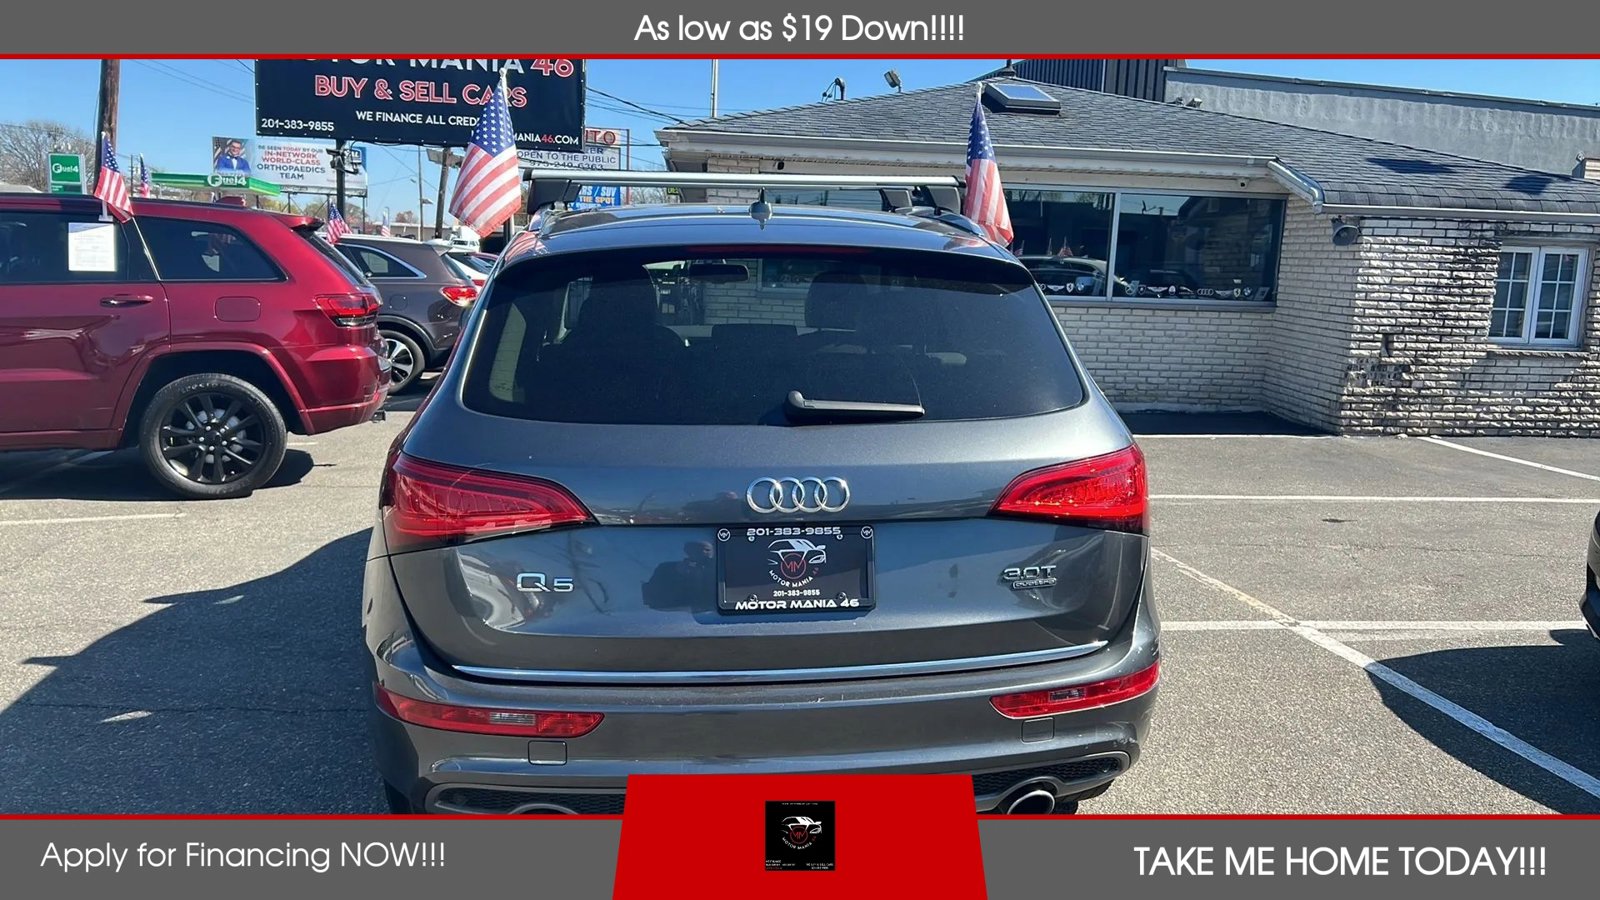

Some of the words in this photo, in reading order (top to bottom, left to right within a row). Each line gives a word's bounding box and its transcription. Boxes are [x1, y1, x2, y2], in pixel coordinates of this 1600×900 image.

[531, 59, 575, 78] 46
[315, 74, 368, 99] BUY
[374, 79, 393, 100] &
[399, 80, 457, 104] SELL
[355, 110, 373, 121] WE
[376, 111, 423, 124] FINANCE
[425, 115, 446, 125] ALL
[448, 115, 480, 126] CRED
[261, 118, 335, 132] 201-383-9855
[586, 130, 616, 145] TO
[265, 151, 317, 159] IN-NETWORK
[588, 147, 604, 155] ER
[262, 157, 321, 166] WORLD-CLASS
[517, 151, 543, 159] OPEN
[547, 152, 559, 160] TO
[562, 154, 580, 162] THE
[582, 155, 616, 164] PUBLIC
[257, 164, 326, 174] ORTHOPAEDICS
[280, 172, 304, 180] TEAM
[601, 186, 617, 196] SUV
[747, 527, 841, 536] 201-383-9855
[769, 570, 791, 587] MOTOR
[792, 576, 814, 588] MANIA
[773, 589, 820, 597] 201-383-9855
[735, 600, 787, 610] MOTOR
[790, 599, 838, 609] MANIA
[840, 598, 860, 608] 46
